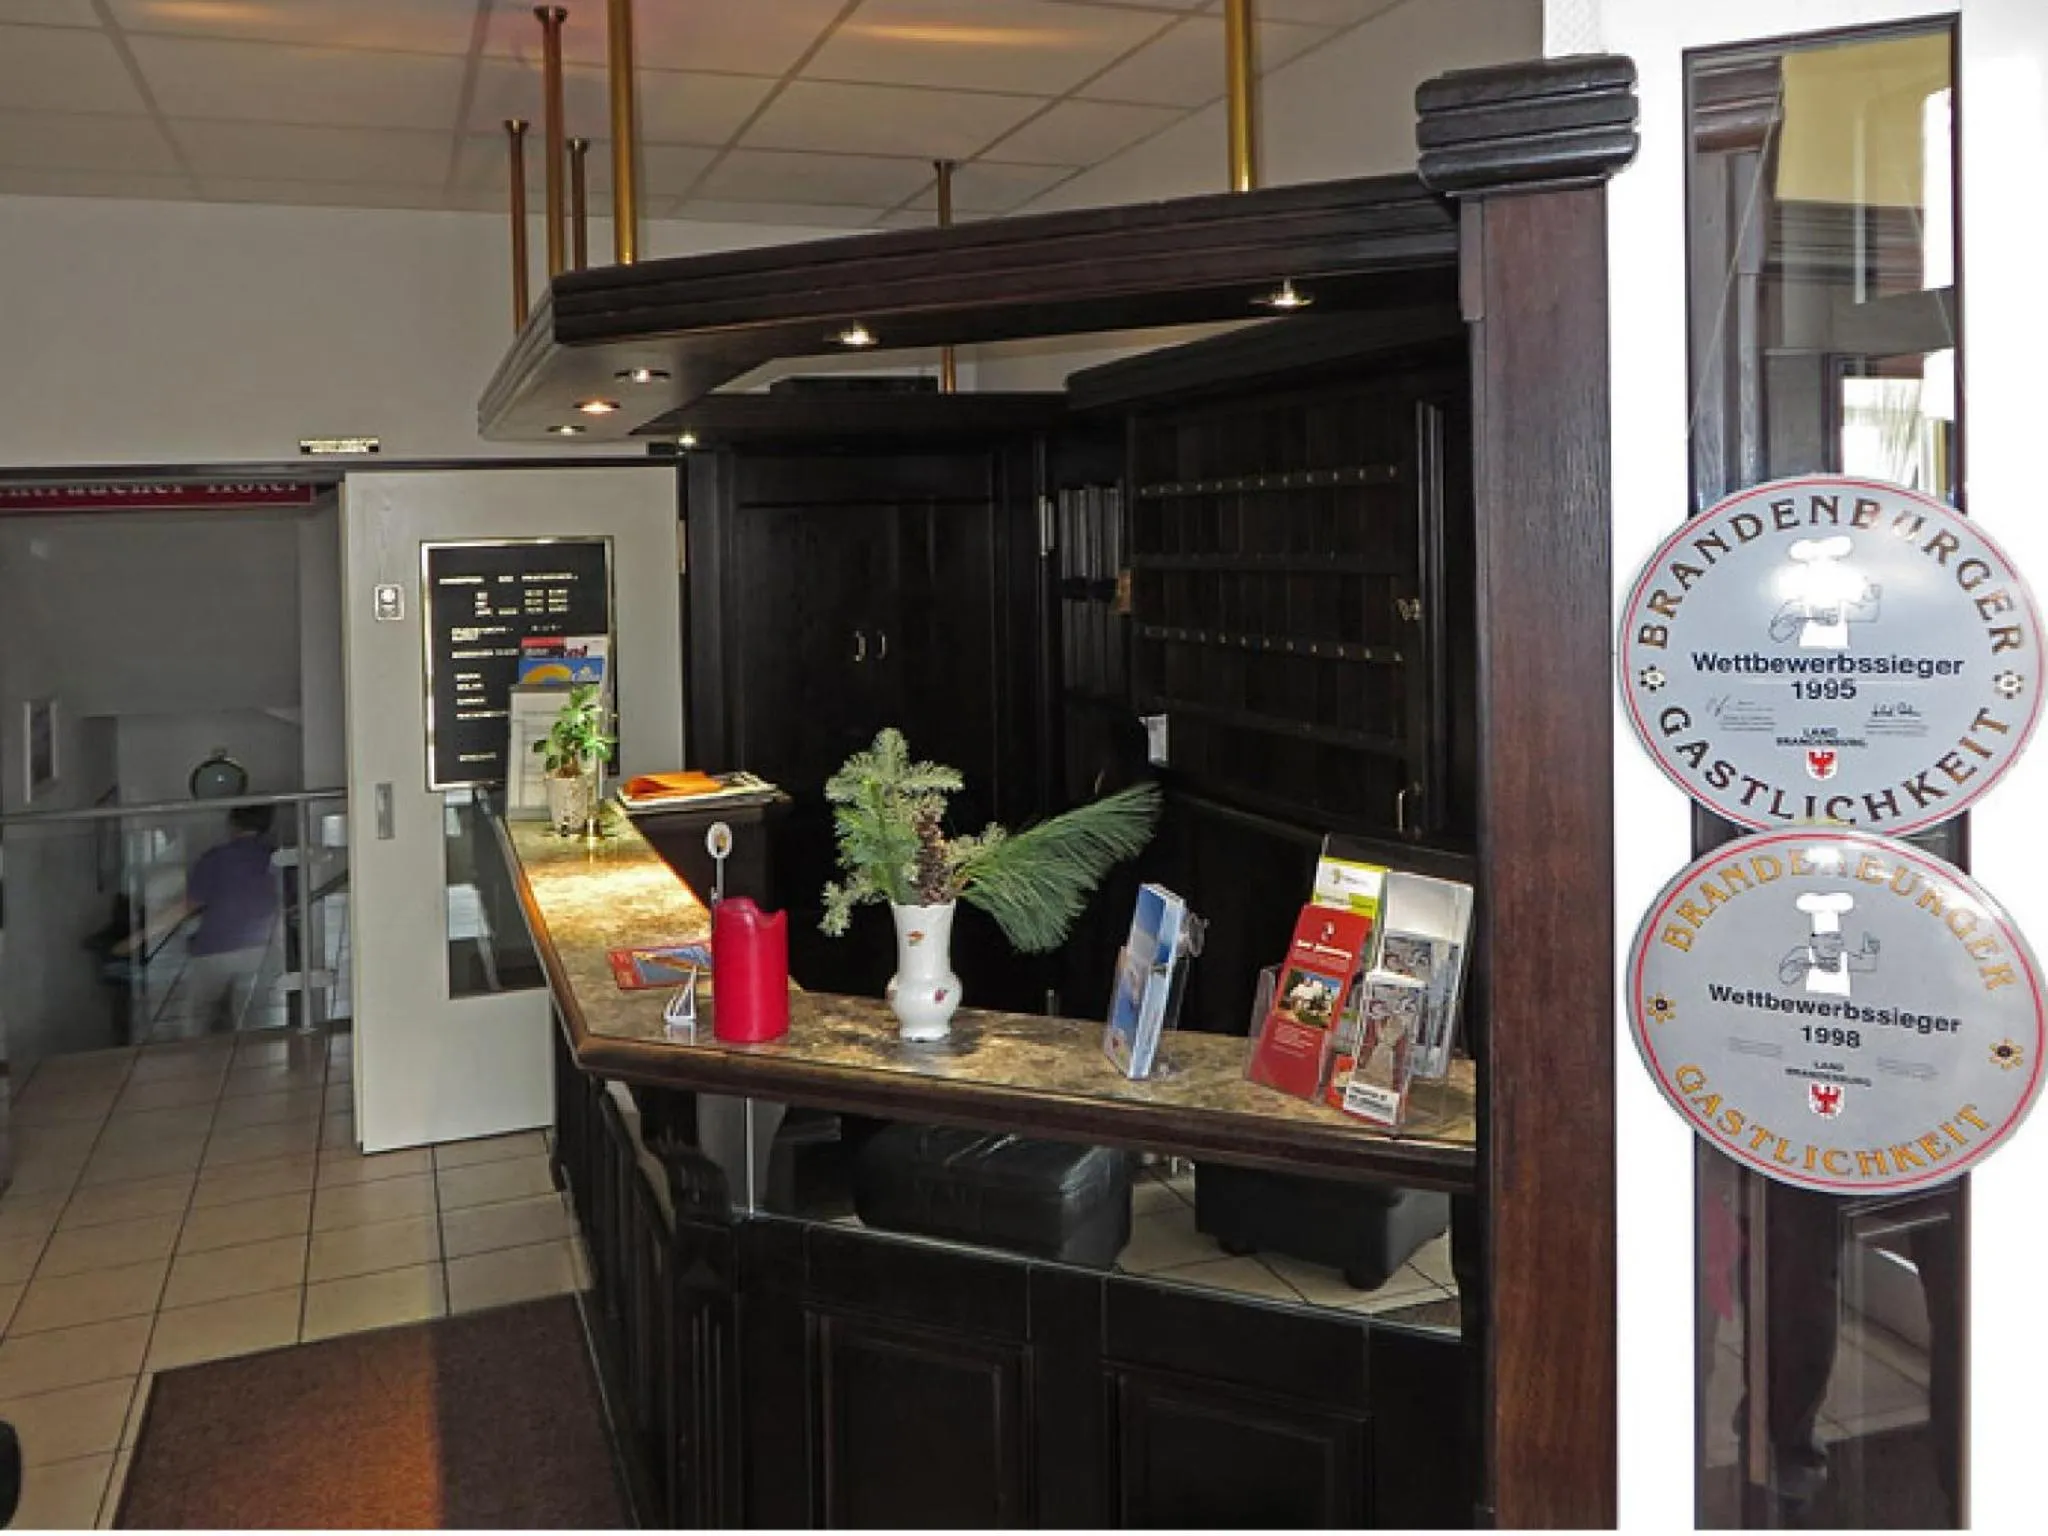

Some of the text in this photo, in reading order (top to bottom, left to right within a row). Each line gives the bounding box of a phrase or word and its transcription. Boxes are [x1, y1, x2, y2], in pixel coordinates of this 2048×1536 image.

[1638, 495, 2025, 654] BRANDENBURGER
[1691, 652, 1965, 679] Wettbewerbssieger
[1791, 679, 1857, 700] 1995
[1660, 706, 2010, 825] GASTLICHKEIT
[1708, 984, 1962, 1034] Wettbewerbssieger
[1802, 1025, 1862, 1049] 1998
[1674, 1063, 1991, 1176] GASTLICHKEIT
